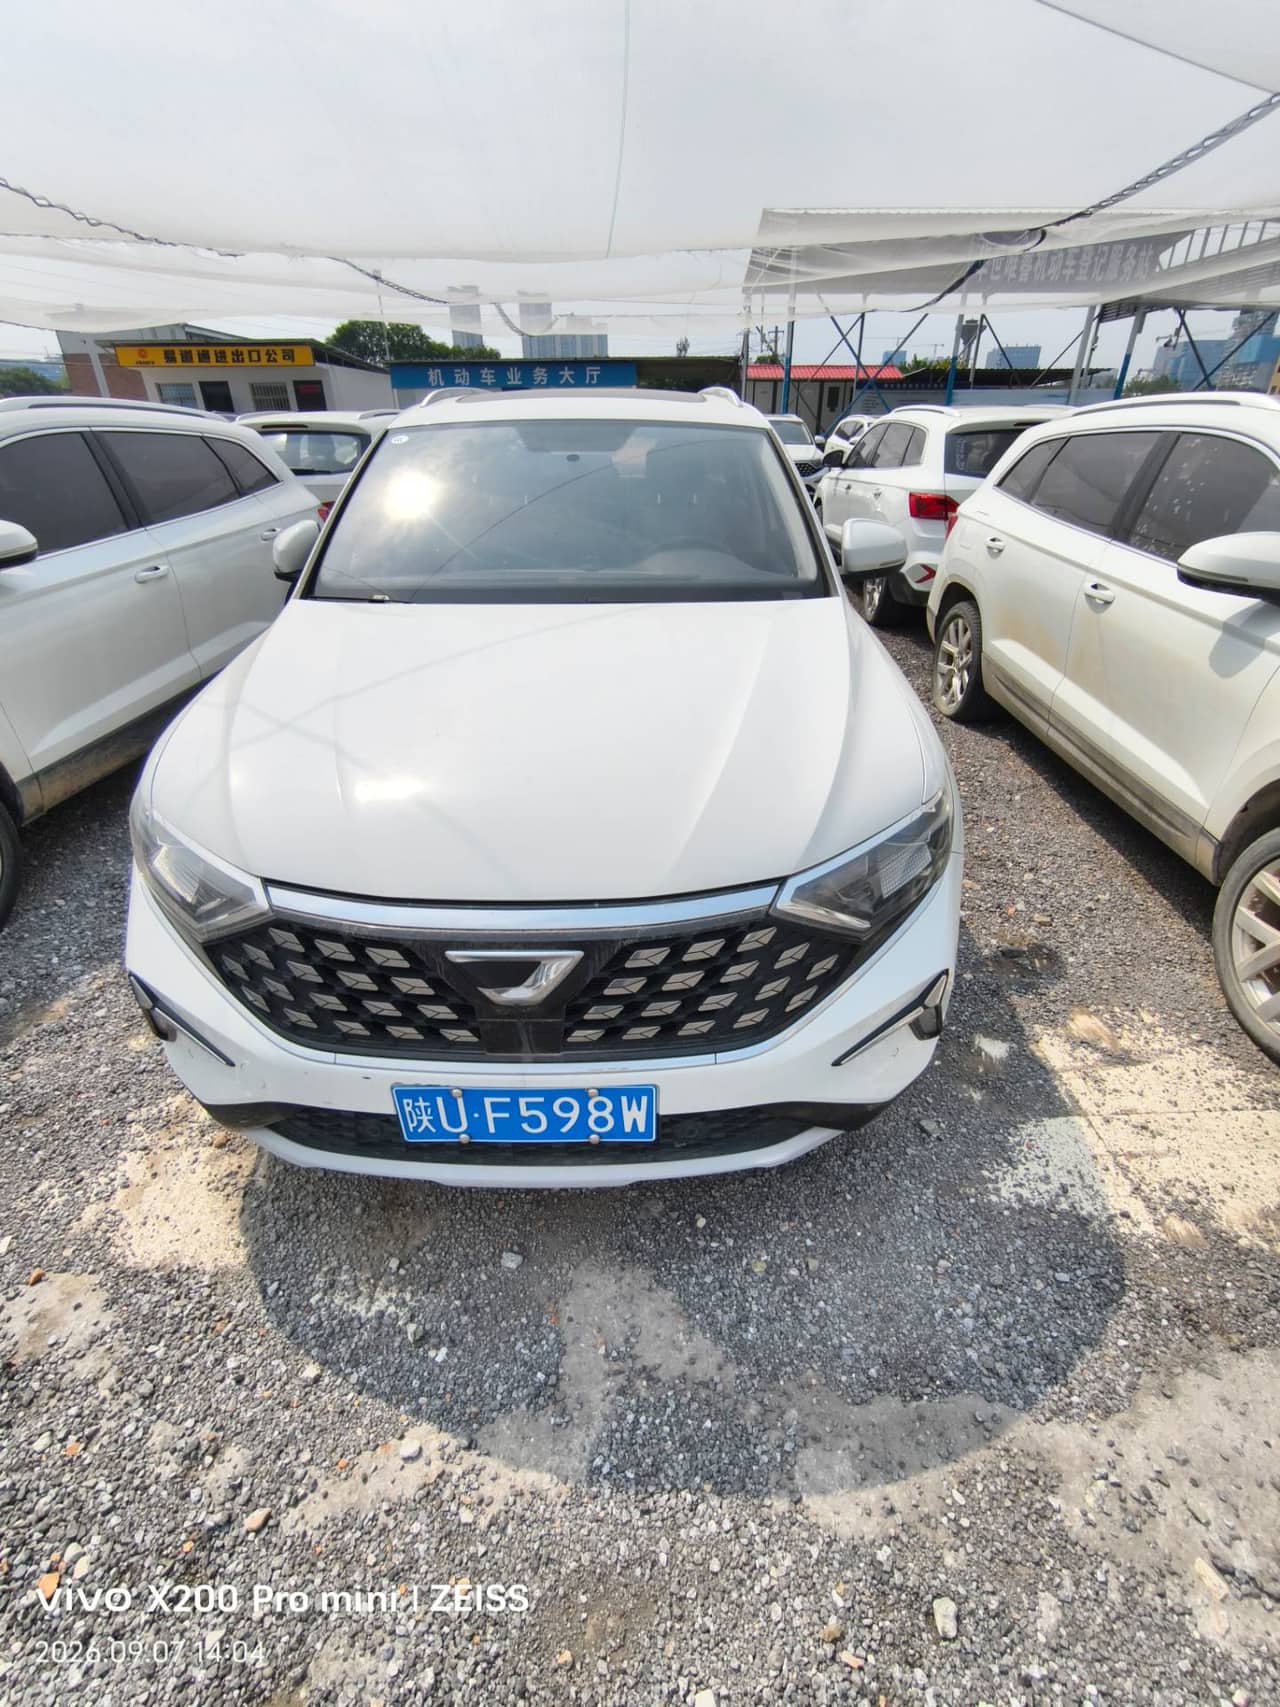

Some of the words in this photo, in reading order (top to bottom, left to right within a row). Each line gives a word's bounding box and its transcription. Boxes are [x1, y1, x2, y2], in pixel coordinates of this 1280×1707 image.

[427, 367, 601, 387] 机动车业务大厅
[403, 1096, 648, 1134] 陕U·F598W
